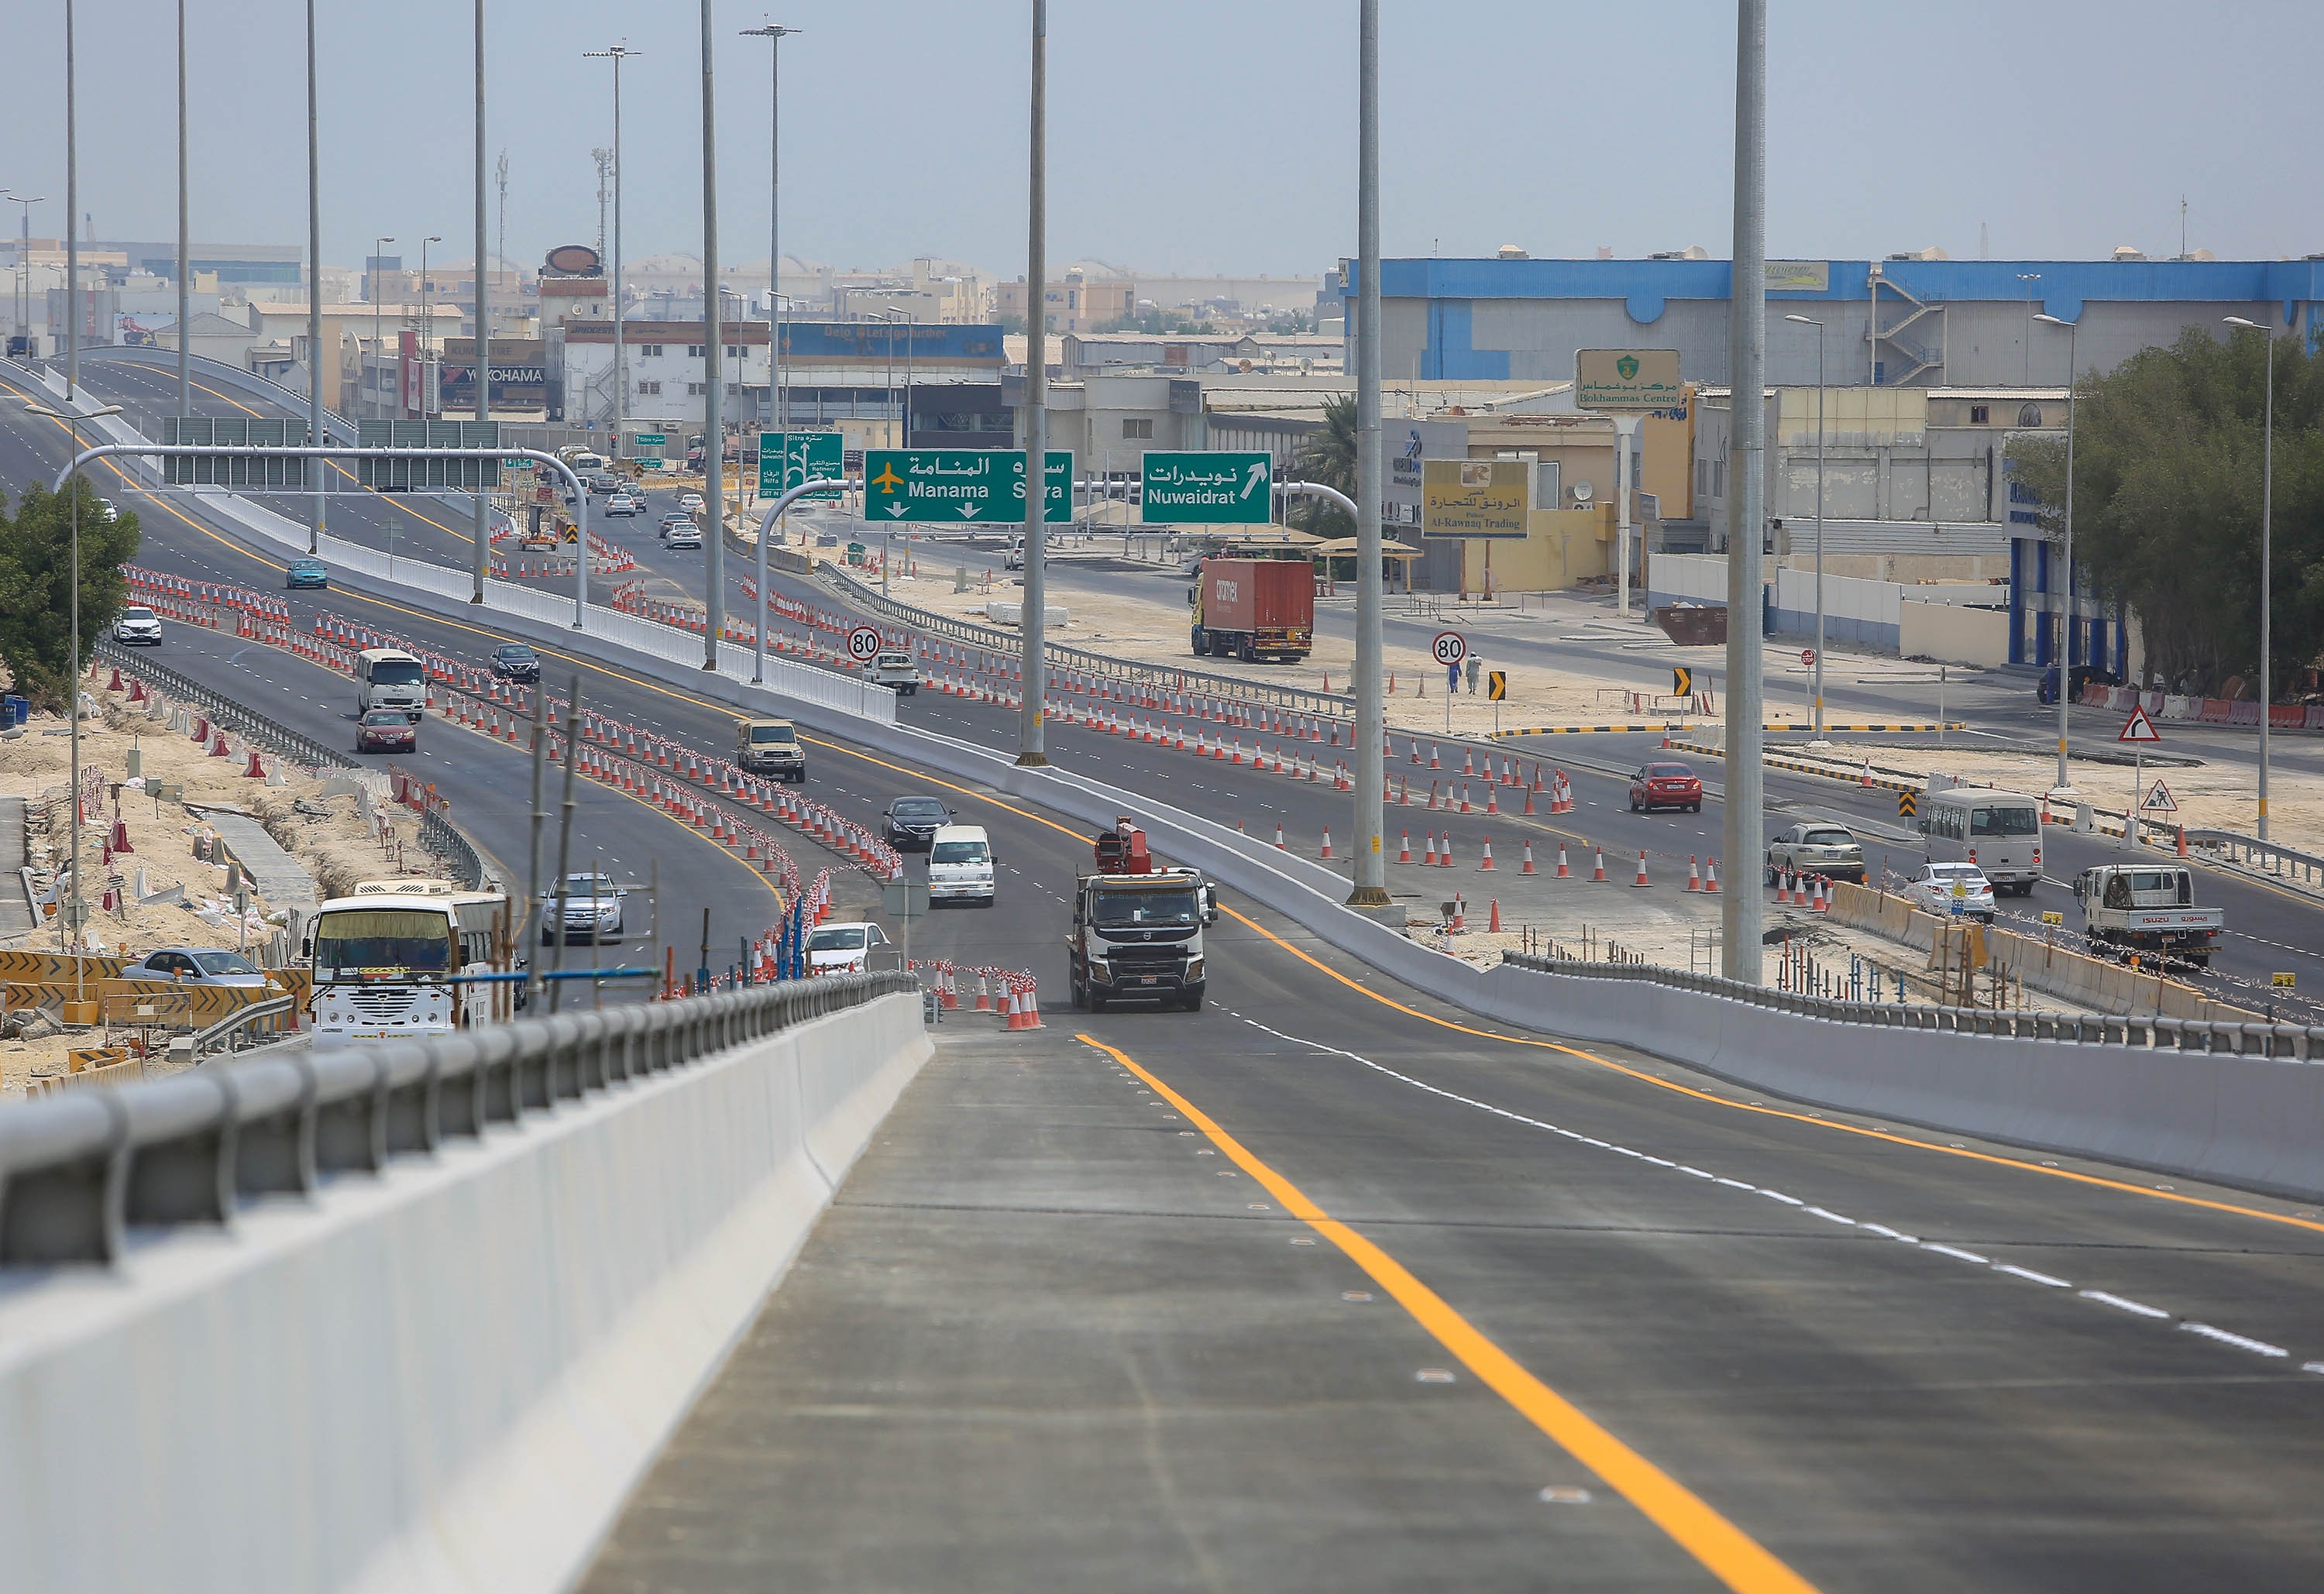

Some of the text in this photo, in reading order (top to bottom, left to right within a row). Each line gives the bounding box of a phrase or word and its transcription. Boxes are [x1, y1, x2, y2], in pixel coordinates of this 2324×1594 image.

[570, 326, 628, 335] BRIDGESTOE
[893, 328, 907, 341] go
[490, 346, 513, 356] TIRE
[466, 369, 543, 382] YKOHAMA
[1641, 381, 1677, 392] مركز
[1580, 393, 1677, 403] Bokhammas Centre
[909, 456, 990, 477] المنامة
[1148, 465, 1238, 486] نويدرات
[908, 481, 989, 498] Manama
[1012, 481, 1063, 499] Sra
[1148, 488, 1236, 505] Nuwaidrat
[1430, 496, 1520, 510] الرونق للتجارة
[1431, 517, 1520, 531] Al-Rawnaq Trading
[853, 634, 877, 653] 80
[1437, 639, 1461, 658] 80
